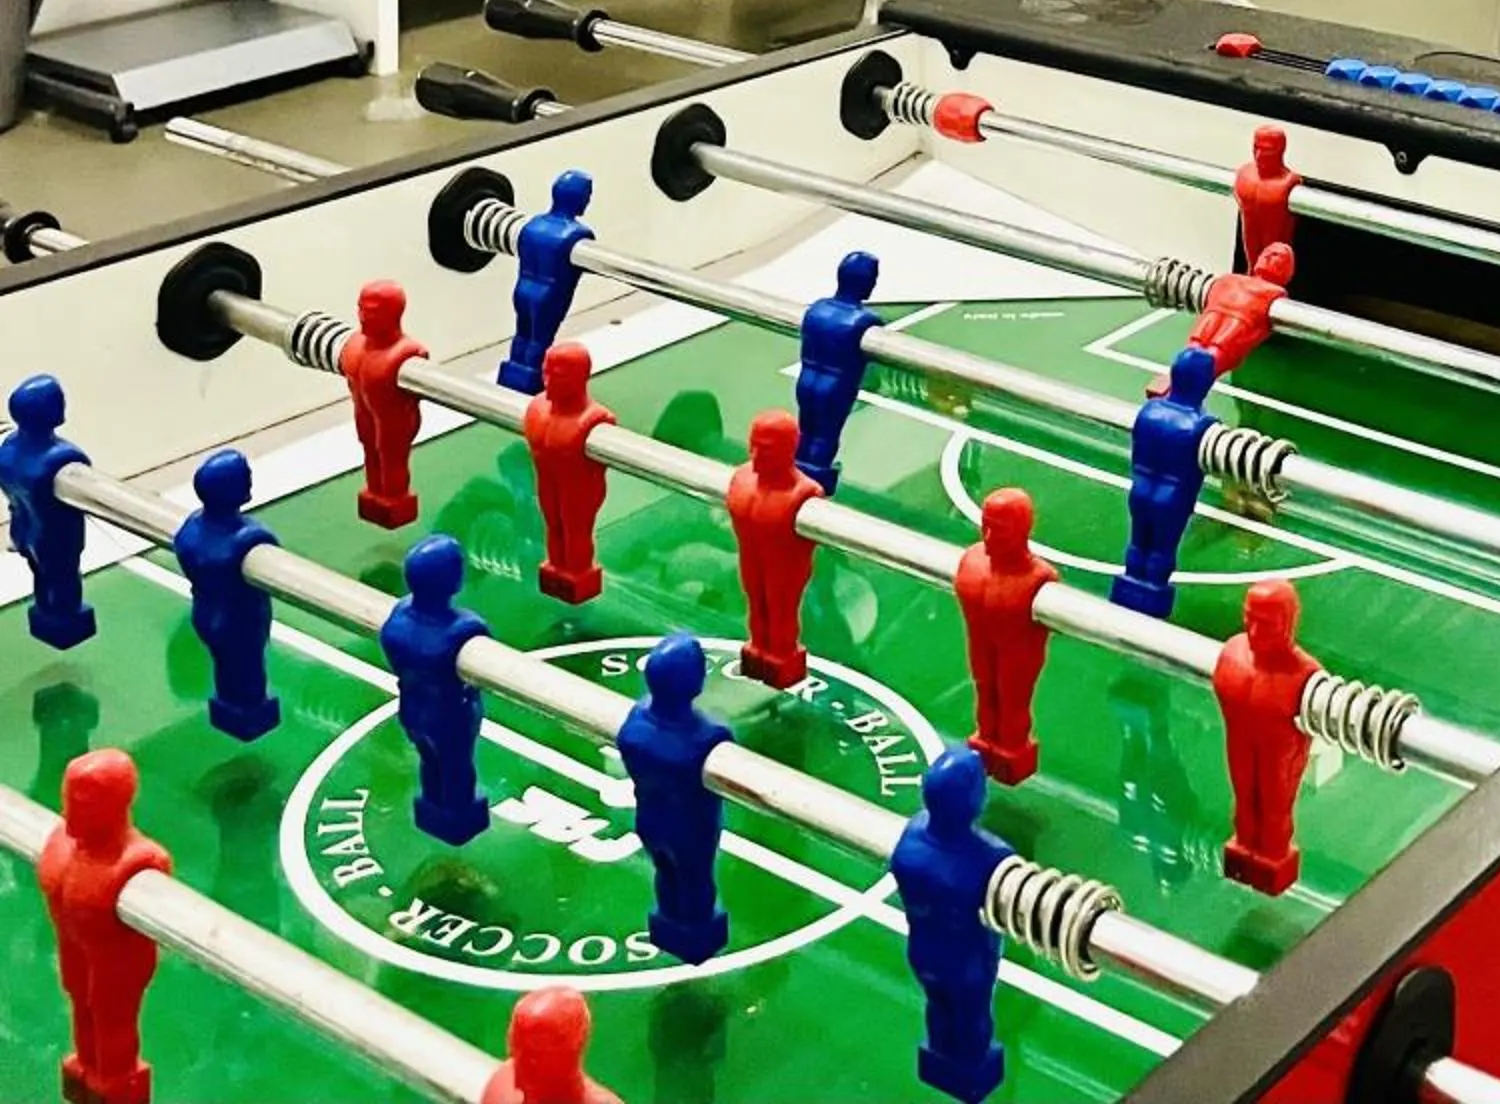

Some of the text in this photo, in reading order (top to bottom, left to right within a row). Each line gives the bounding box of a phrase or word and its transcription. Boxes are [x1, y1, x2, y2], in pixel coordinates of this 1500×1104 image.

[845, 707, 924, 797] BALL
[316, 788, 658, 967] SOCCER BALL
